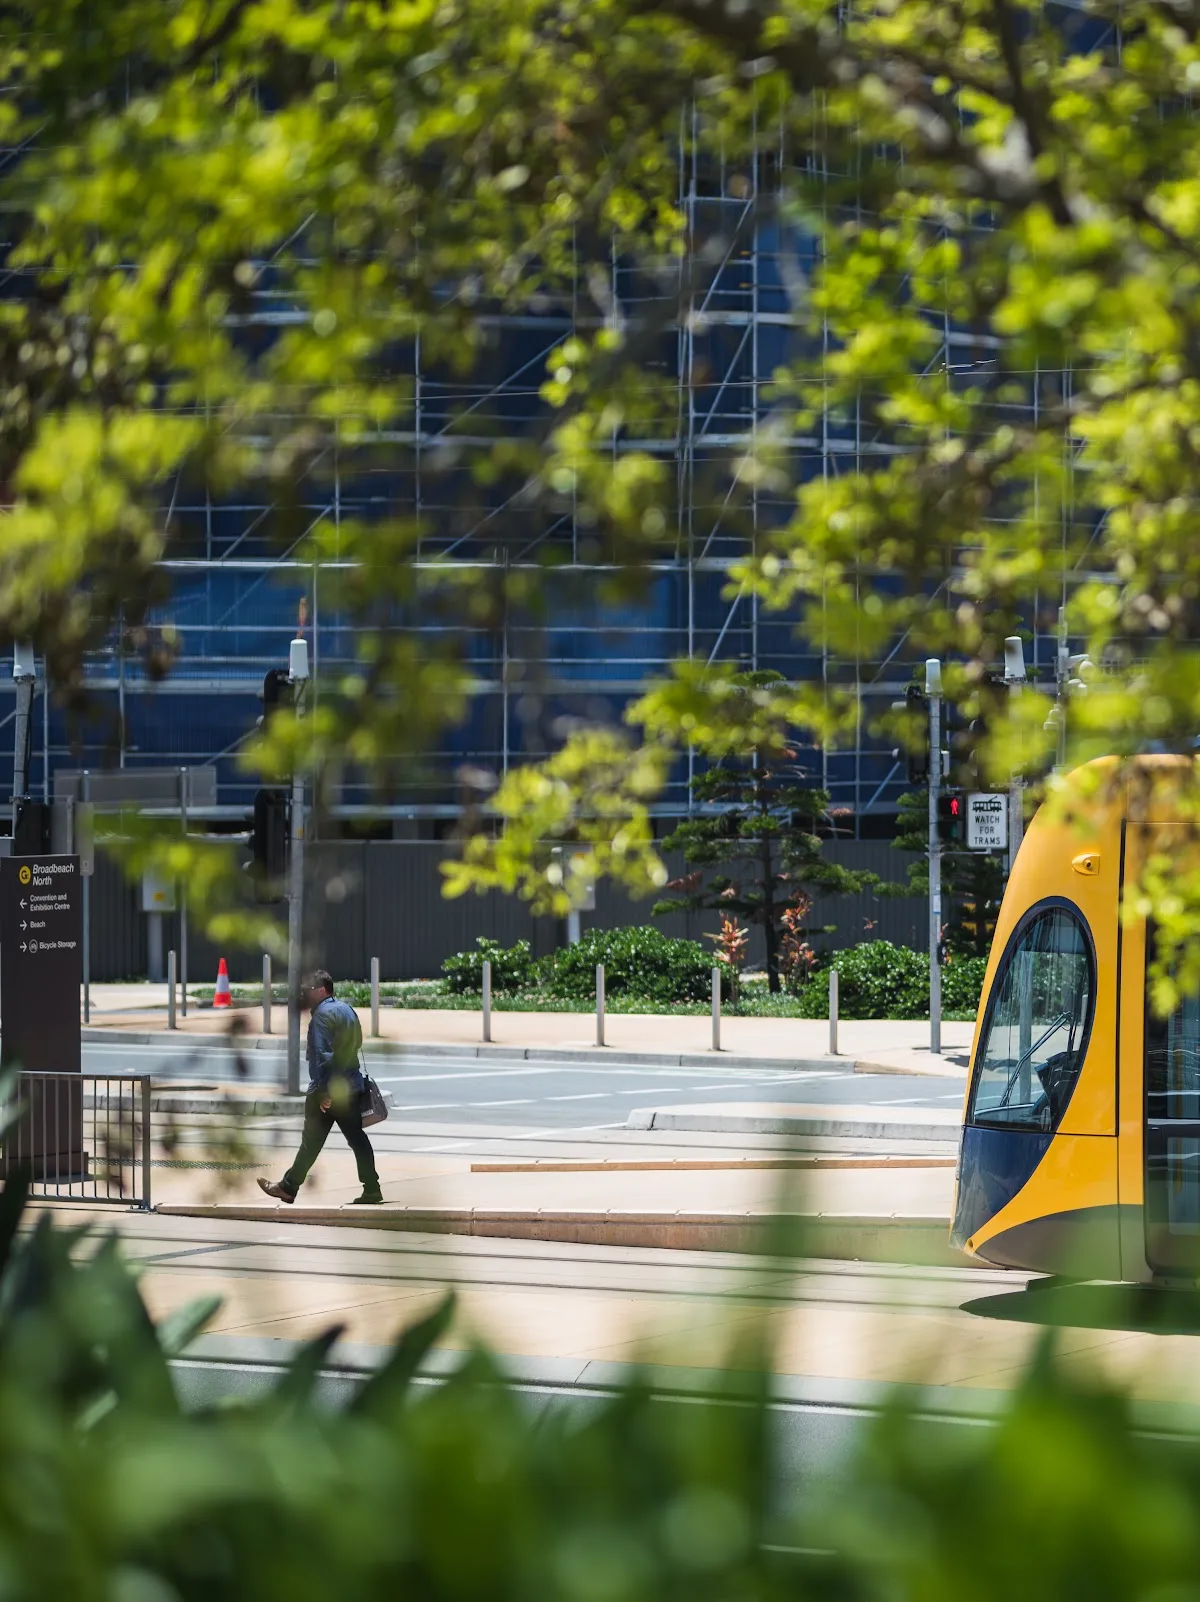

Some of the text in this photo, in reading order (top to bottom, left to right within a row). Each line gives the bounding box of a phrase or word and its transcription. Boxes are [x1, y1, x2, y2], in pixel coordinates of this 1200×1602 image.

[974, 815, 1000, 824] WATCH
[979, 826, 995, 834] FOR
[974, 836, 1001, 845] TRAMS
[33, 863, 74, 874] Broadbeach
[33, 876, 52, 886] North
[30, 893, 67, 902] Convention and
[54, 903, 70, 911] Centre
[39, 940, 77, 951] Bicycle Storage
